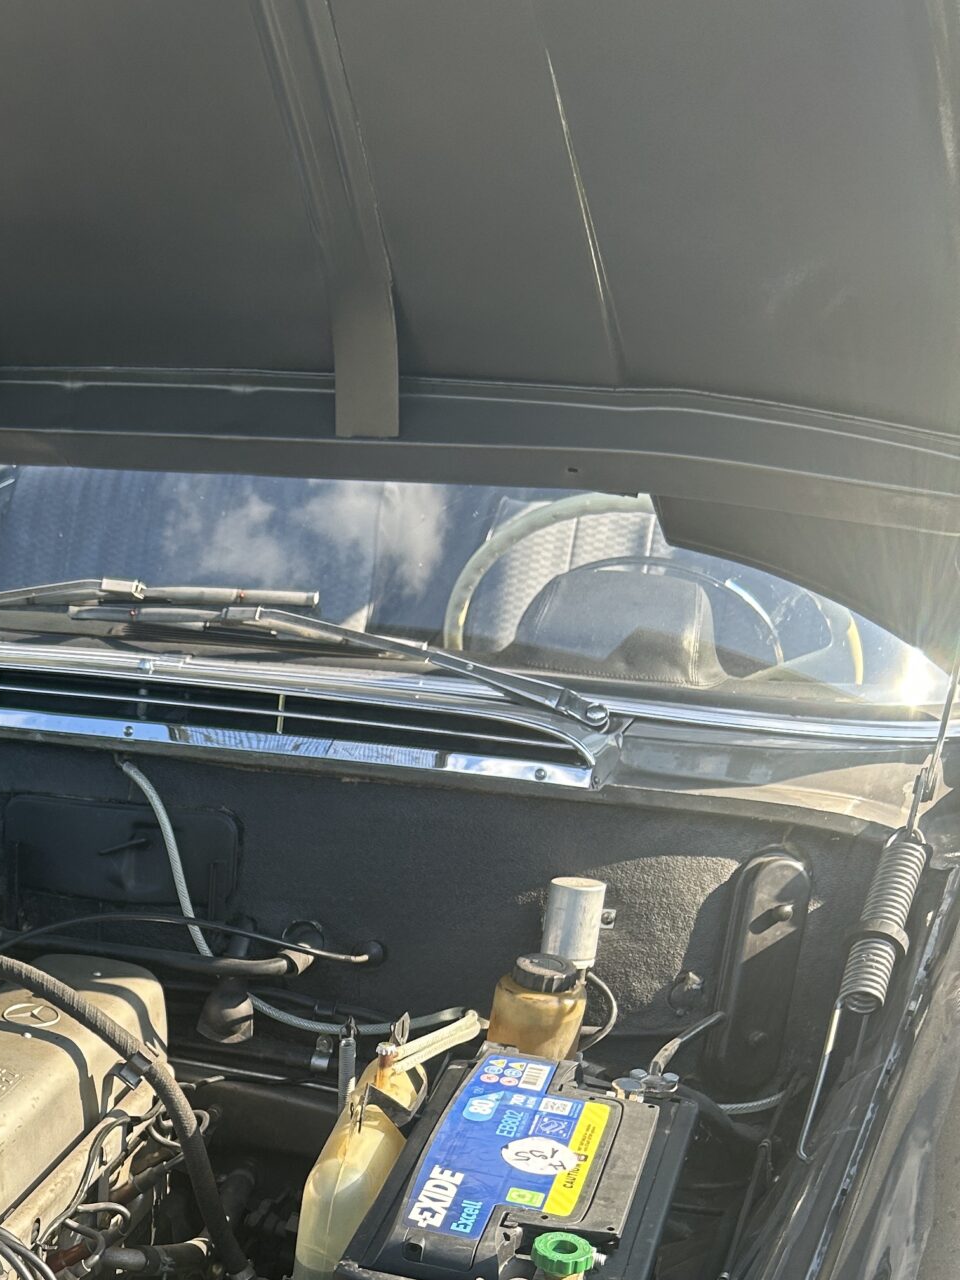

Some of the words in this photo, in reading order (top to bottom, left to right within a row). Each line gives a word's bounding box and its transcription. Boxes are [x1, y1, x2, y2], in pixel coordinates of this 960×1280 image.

[496, 1109, 524, 1138] EB802
[408, 1164, 465, 1228] EXIDE
[450, 1199, 483, 1233] Excell
